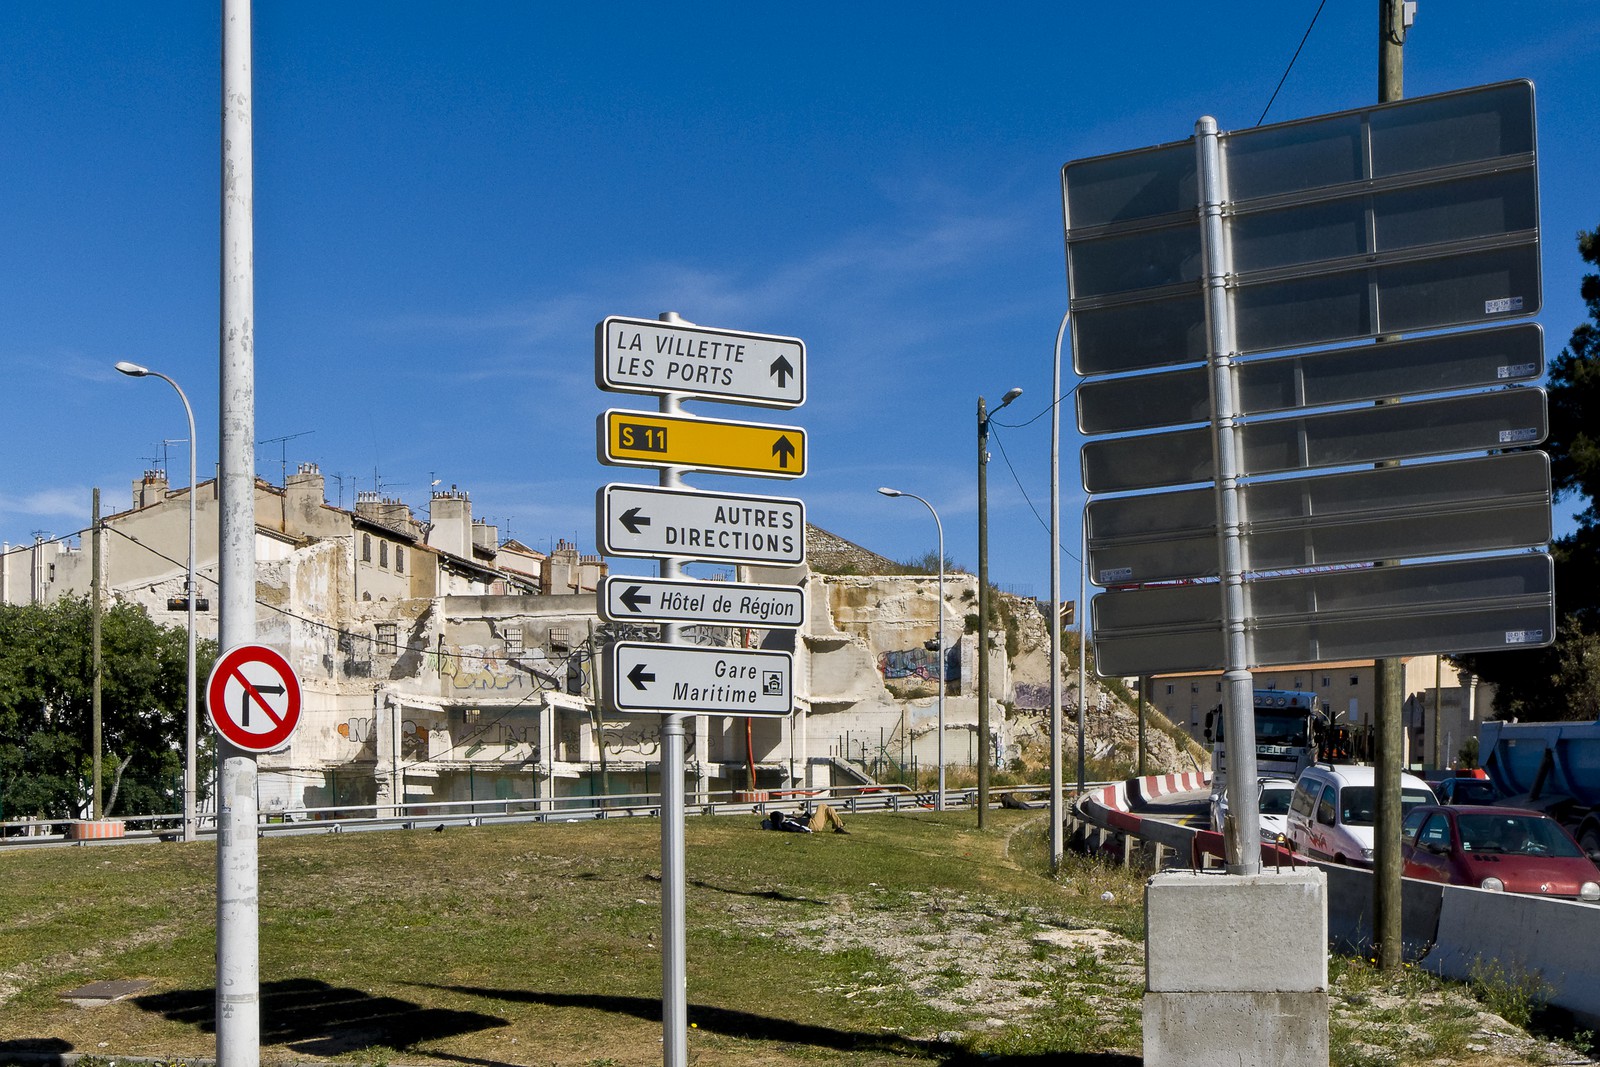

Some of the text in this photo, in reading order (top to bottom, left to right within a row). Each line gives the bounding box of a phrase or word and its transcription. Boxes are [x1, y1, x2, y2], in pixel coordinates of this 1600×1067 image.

[617, 331, 745, 363] LA VILLETTE
[617, 356, 733, 386] LES PORTS
[622, 427, 664, 449] S 11
[714, 506, 794, 529] AUTRES
[666, 526, 794, 553] DIRECTIONS
[660, 592, 794, 620] Hôtel de Région
[715, 660, 756, 679] Gare
[673, 682, 756, 703] Maritime
